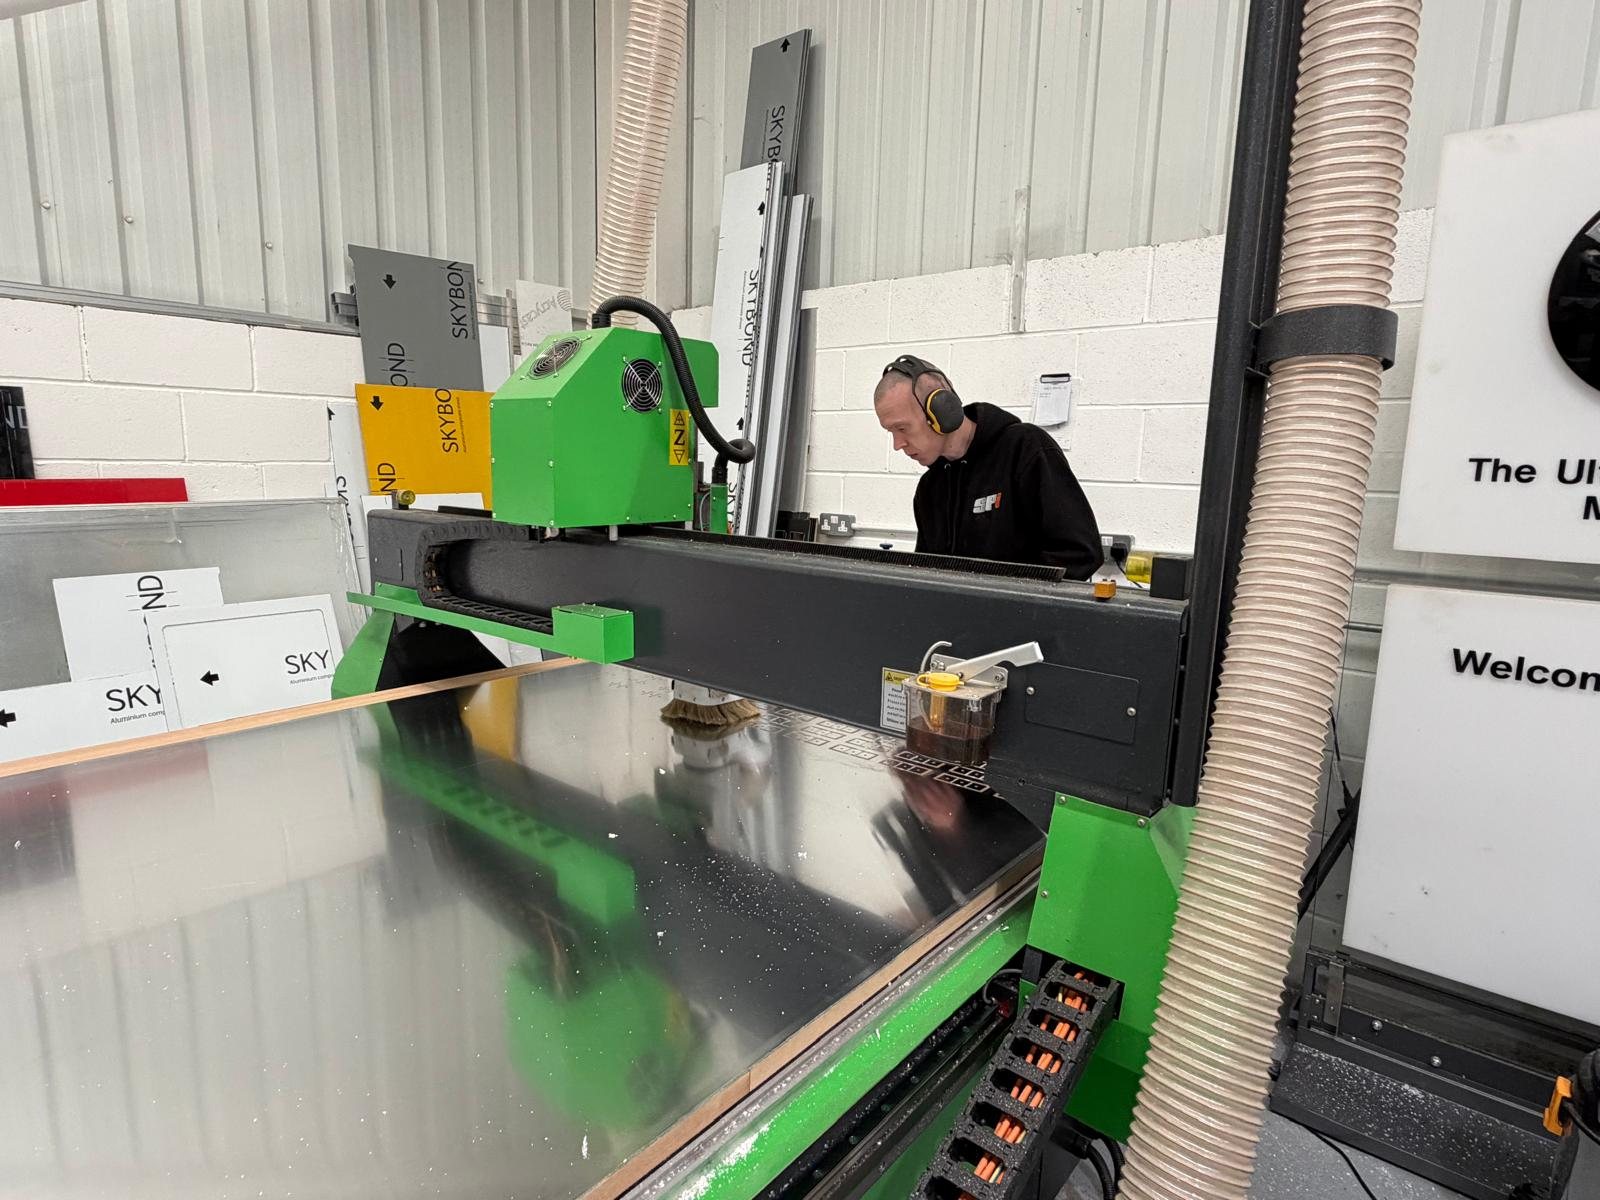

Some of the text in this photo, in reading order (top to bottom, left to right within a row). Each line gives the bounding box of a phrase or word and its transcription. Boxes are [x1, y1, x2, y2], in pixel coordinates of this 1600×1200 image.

[767, 105, 785, 162] SKYB
[435, 388, 459, 453] SKYBO
[674, 429, 686, 446] Z
[1468, 458, 1600, 485] The Ul
[285, 649, 328, 675] SKY
[106, 684, 161, 712] SKY
[110, 713, 147, 724] Aluminium
